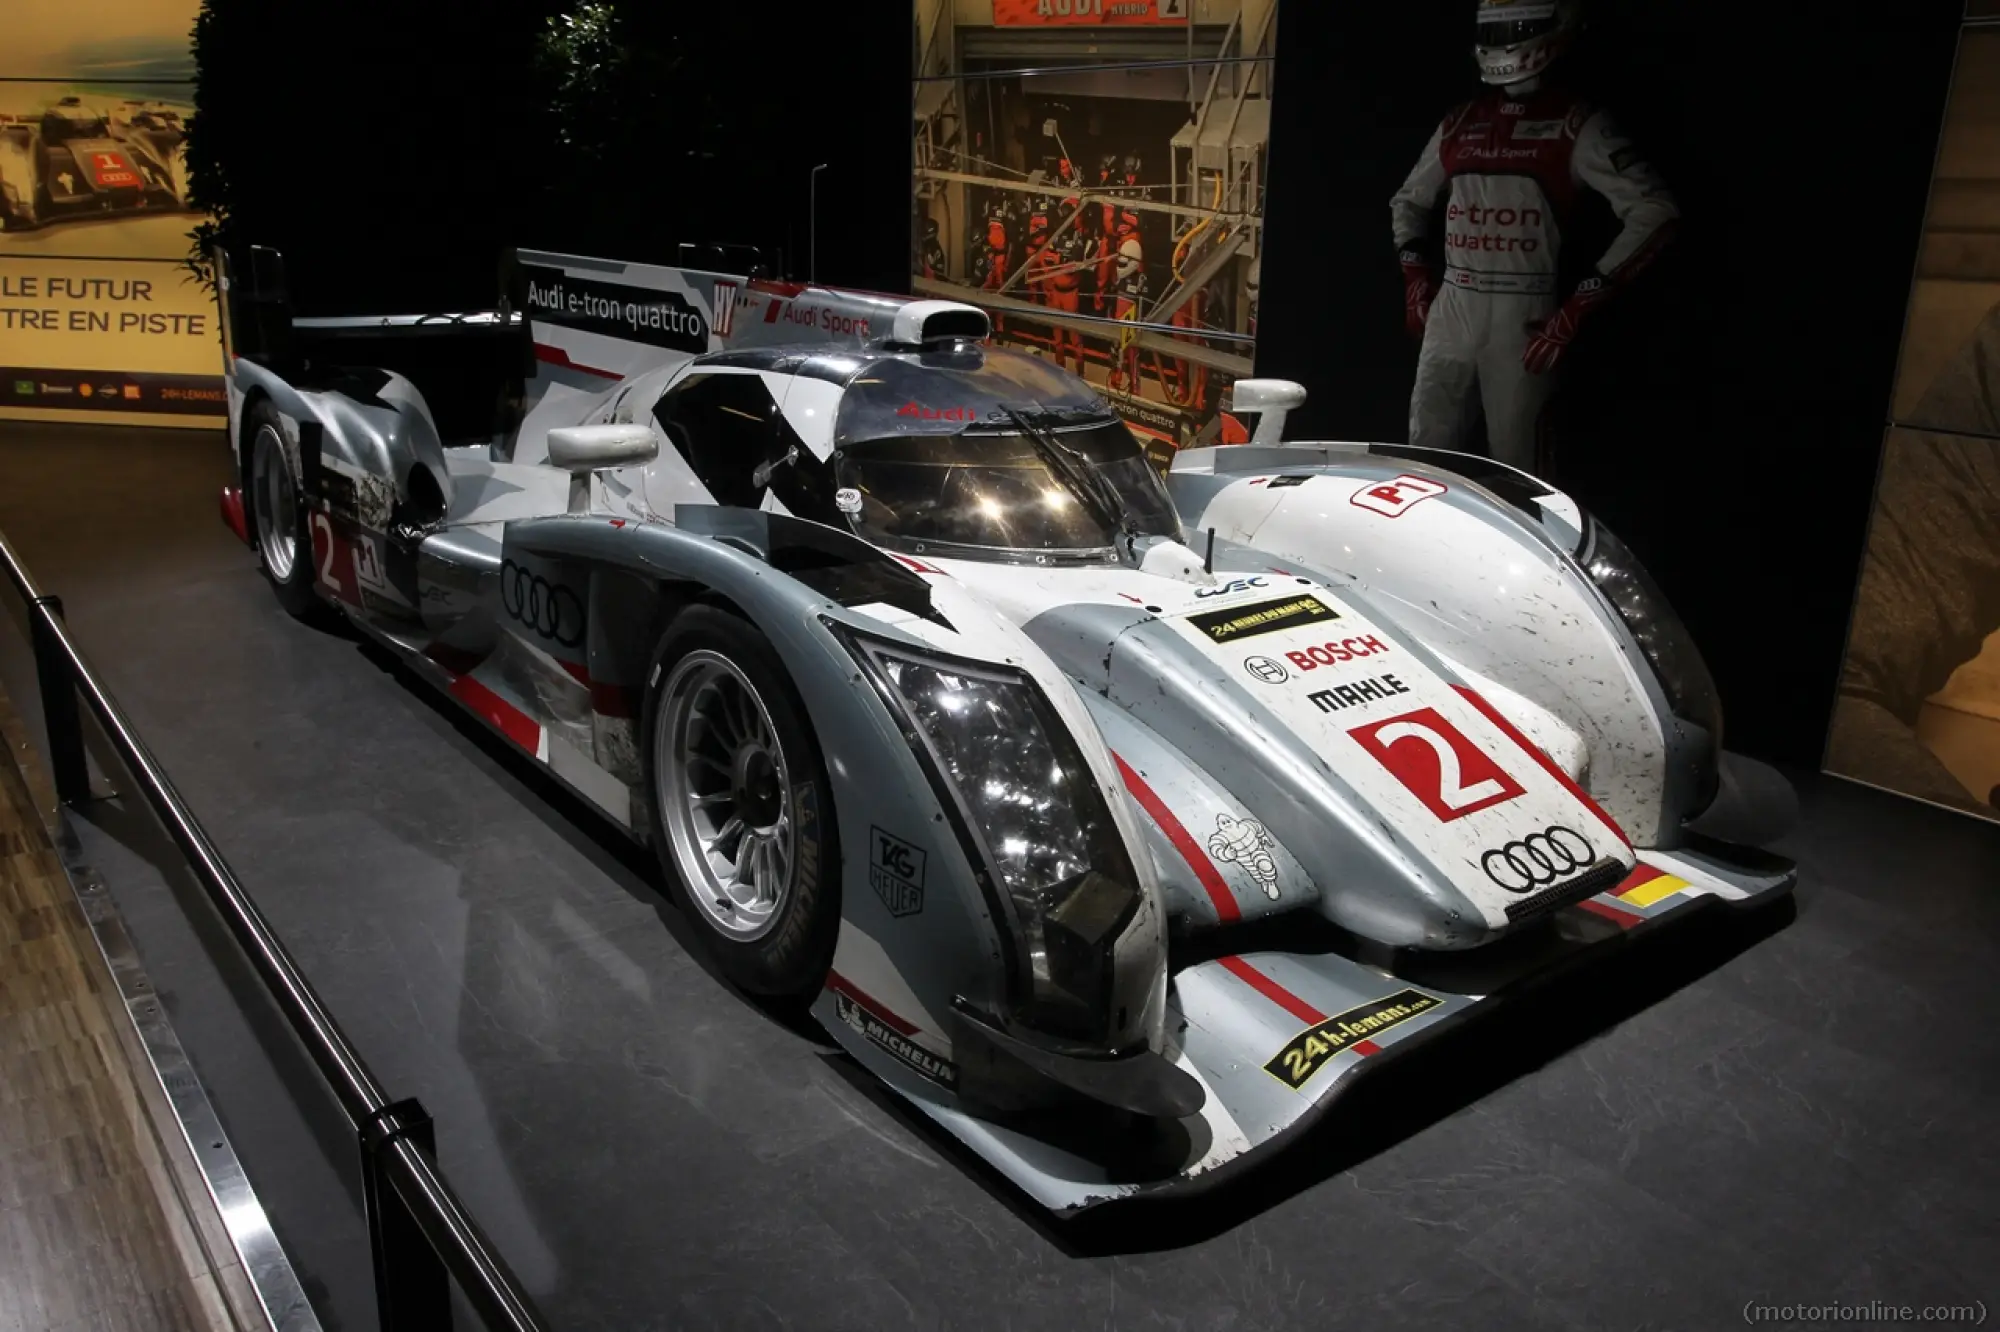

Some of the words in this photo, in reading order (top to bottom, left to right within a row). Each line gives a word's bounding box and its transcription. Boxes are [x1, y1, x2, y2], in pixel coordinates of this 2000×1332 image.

[1501, 147, 1539, 159] Sport
[1448, 204, 1541, 226] e-tron
[2, 276, 38, 298] LE
[47, 278, 153, 301] FUTUR
[69, 310, 109, 332] EN
[119, 312, 206, 335] PISTE
[527, 280, 564, 310] Audi
[568, 292, 621, 320] e-tron
[625, 302, 701, 337] quattro
[783, 302, 817, 327] Audi
[821, 308, 868, 337] Sport
[896, 400, 976, 422] Audi
[1366, 482, 1430, 505] P1
[315, 513, 342, 593] 2
[359, 542, 378, 579] P1
[1194, 576, 1269, 598] WEC
[1284, 634, 1390, 671] BOSCH
[1306, 673, 1411, 713] MAHLE
[1374, 721, 1506, 812] 2
[879, 836, 916, 879] TAG
[873, 868, 918, 912] HEUER
[866, 1019, 957, 1083] MICHELIN
